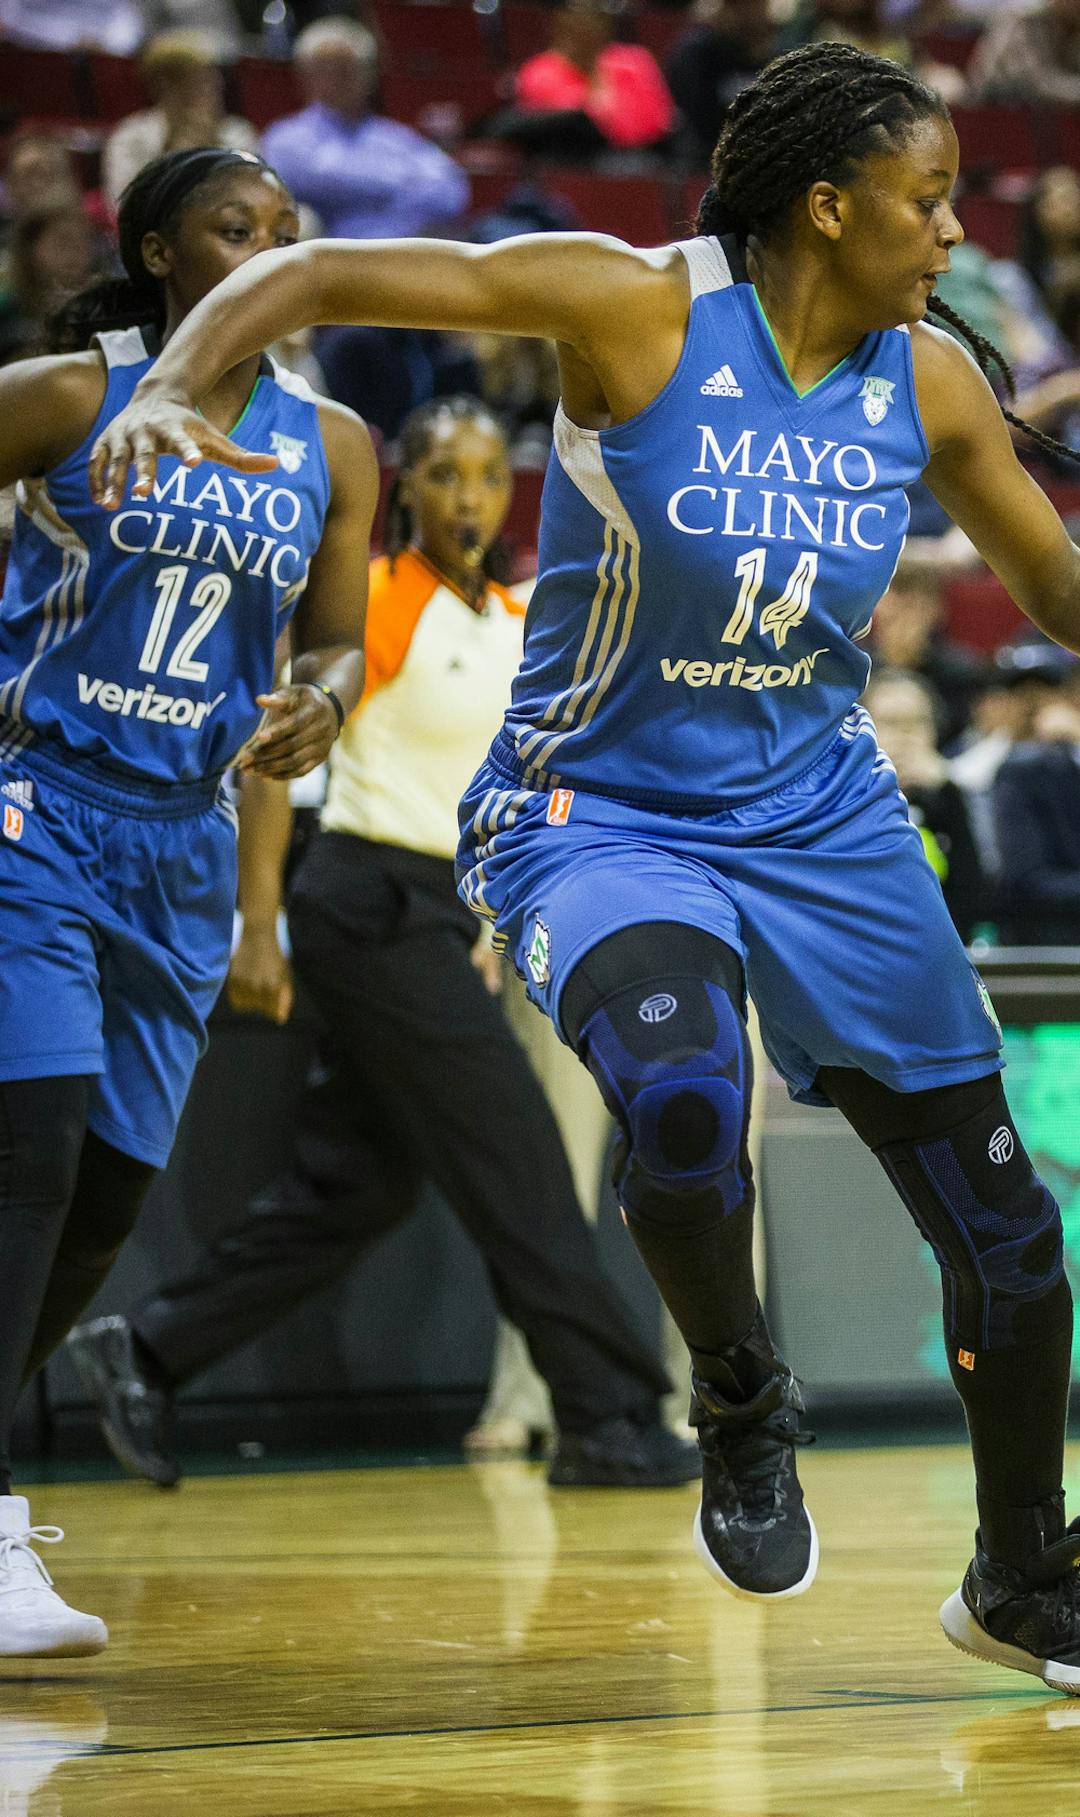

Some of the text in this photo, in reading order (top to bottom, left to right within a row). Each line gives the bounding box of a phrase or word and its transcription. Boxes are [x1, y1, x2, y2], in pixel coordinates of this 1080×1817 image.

[700, 384, 744, 398] adidas
[692, 425, 877, 491] MAYO
[131, 465, 302, 533] MAYO
[667, 484, 887, 550] CLINIC
[109, 510, 301, 588] CLINIC
[138, 564, 232, 683] 12
[721, 548, 818, 650] 14
[660, 655, 812, 691] verizon
